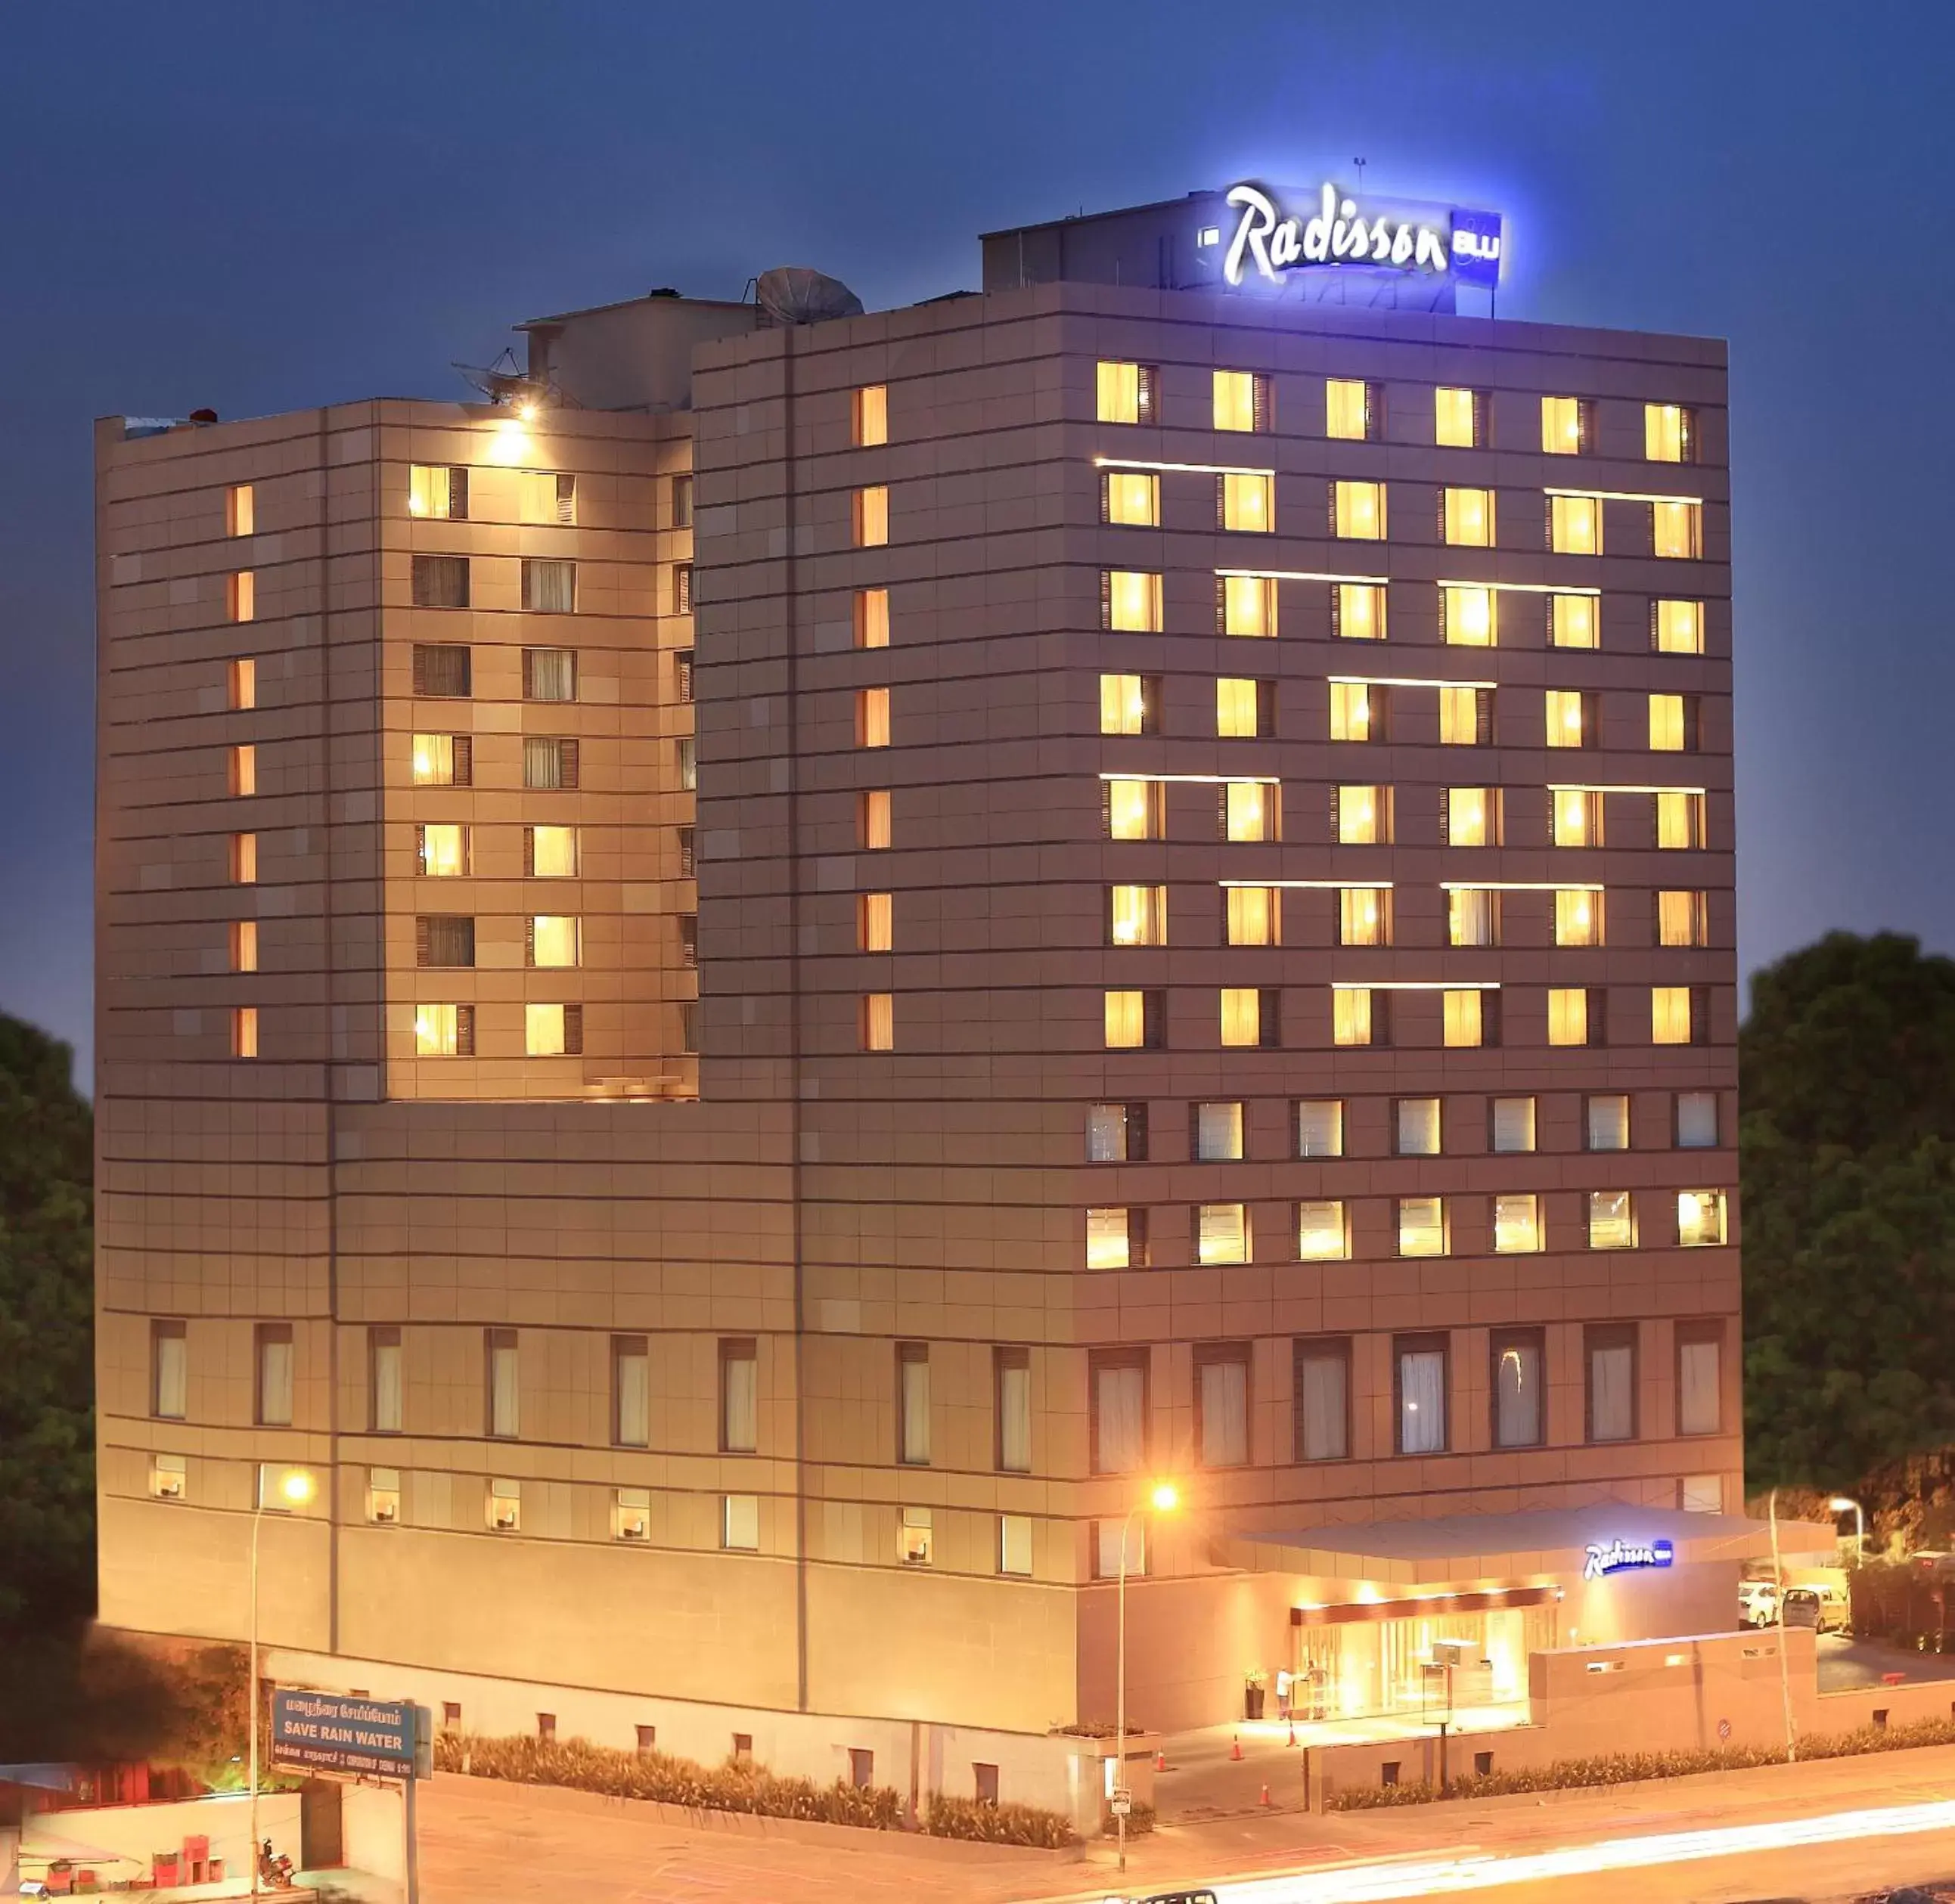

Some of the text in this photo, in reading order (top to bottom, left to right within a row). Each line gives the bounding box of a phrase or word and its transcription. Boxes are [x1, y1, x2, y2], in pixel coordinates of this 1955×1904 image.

[1224, 181, 1500, 285] Radisson BLU
[284, 1720, 402, 1751] SAVE RAIN WATER
